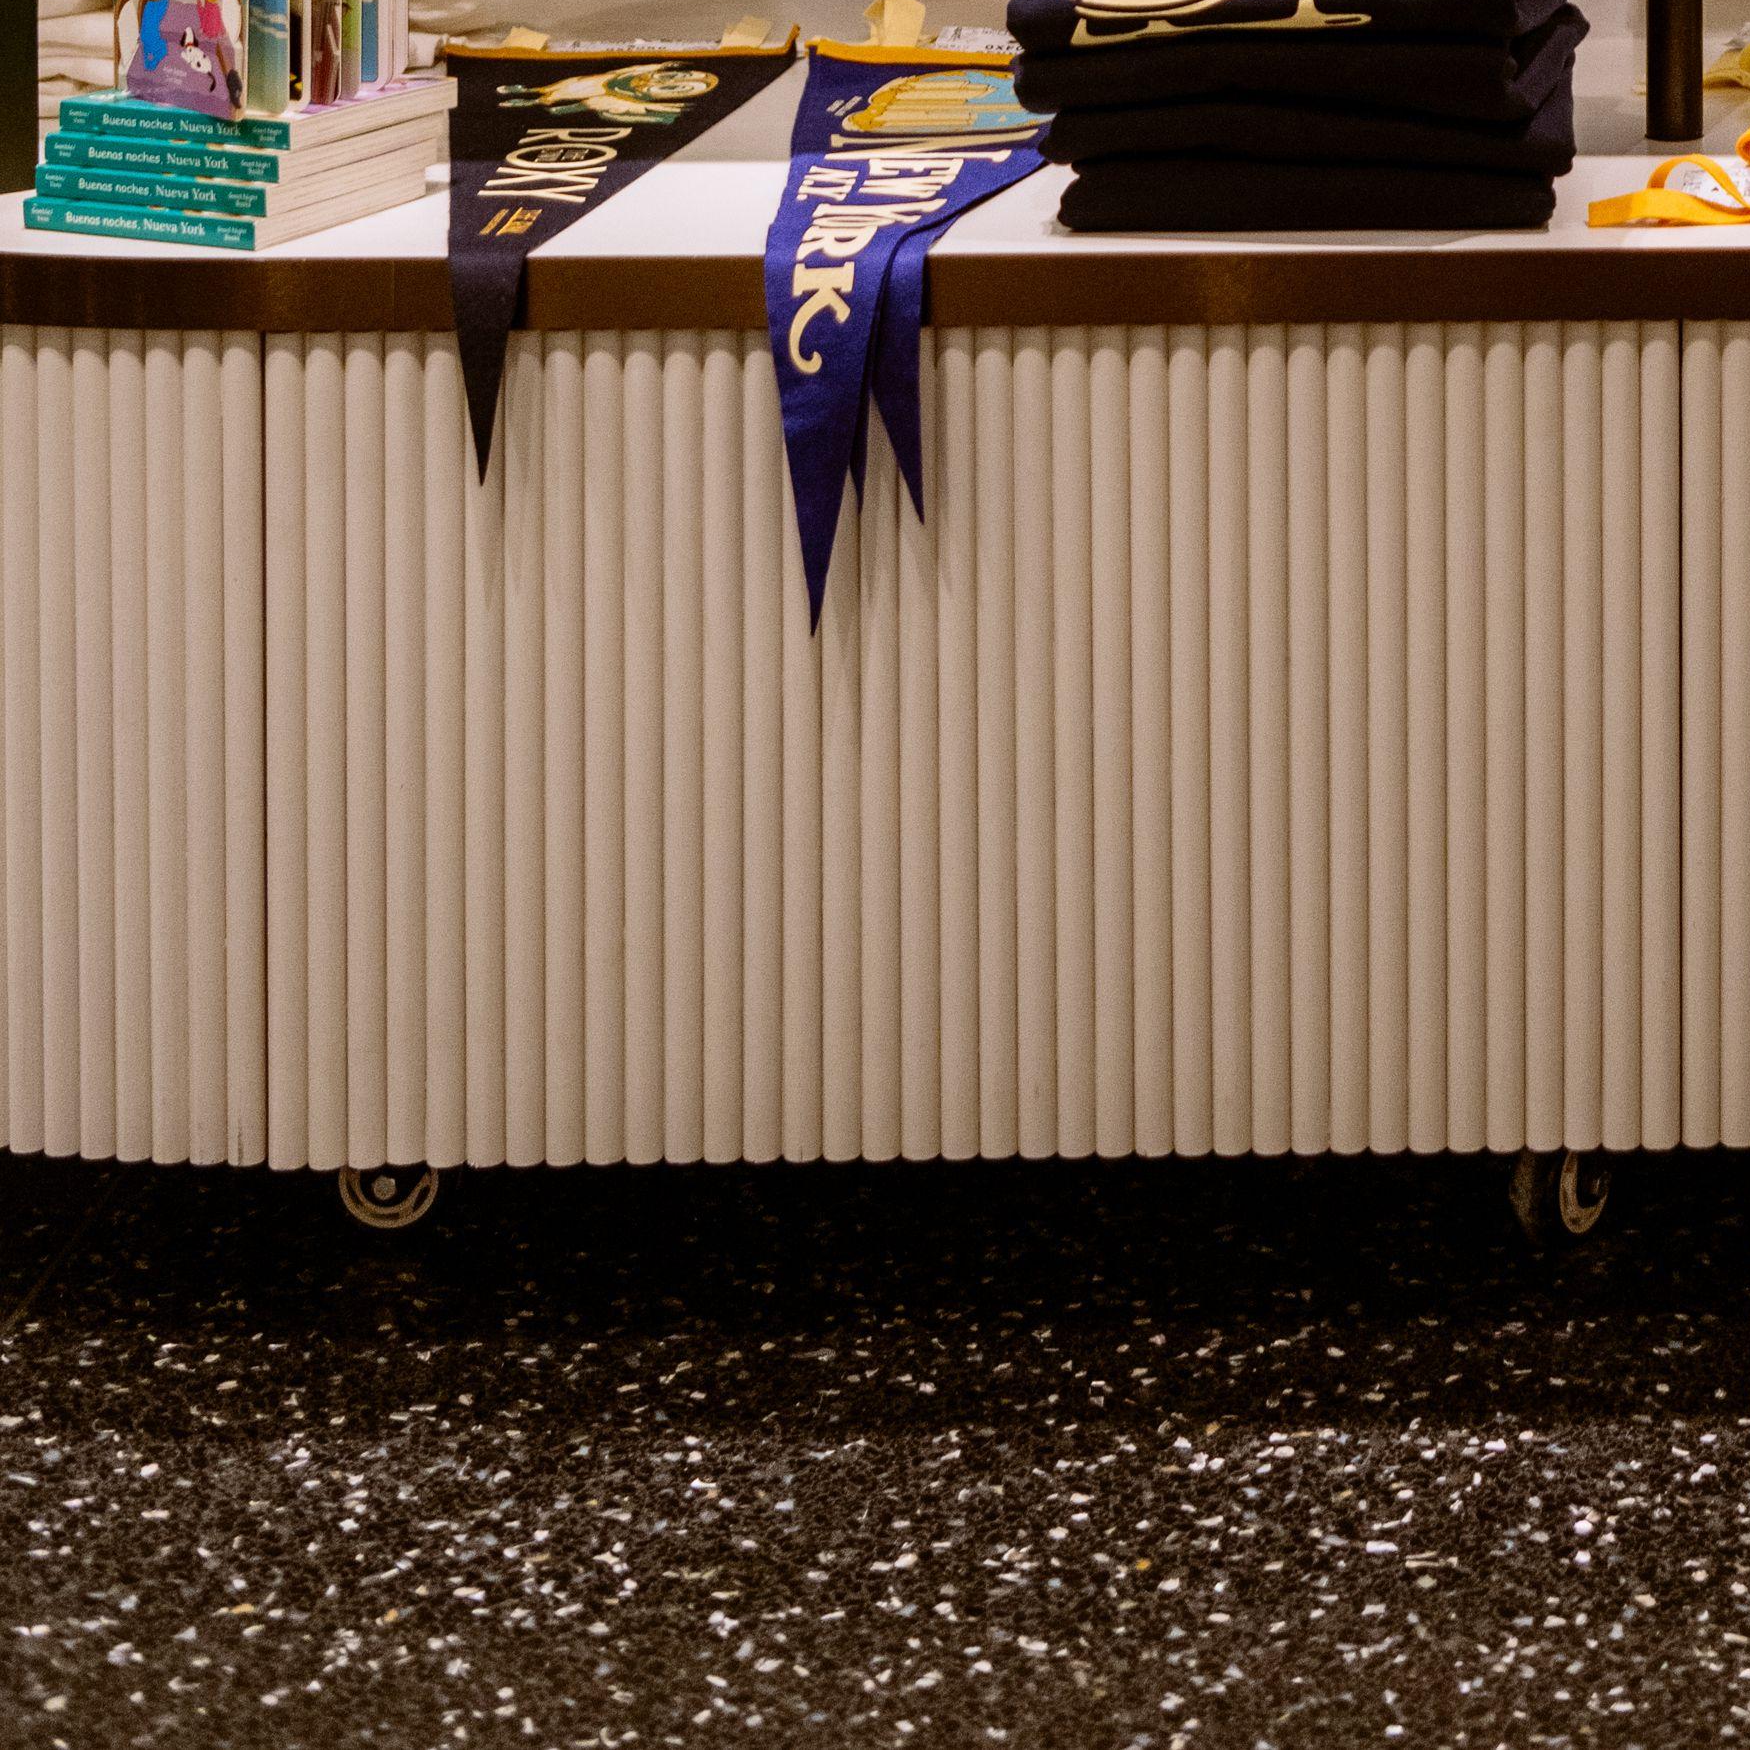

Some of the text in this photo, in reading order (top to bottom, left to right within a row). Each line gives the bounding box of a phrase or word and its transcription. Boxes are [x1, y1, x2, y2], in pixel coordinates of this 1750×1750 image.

[102, 114, 241, 137] Buenas noches, Nueva York
[88, 146, 123, 161] Buenas
[125, 150, 163, 165] noches,
[166, 153, 201, 167] Nueva
[203, 156, 229, 170] York
[477, 126, 633, 203] ROXY
[78, 178, 217, 202] Buenas noches, Nueva York
[65, 211, 206, 236] Buenas noches, Nueva York
[788, 128, 1039, 375] NEW YORK
